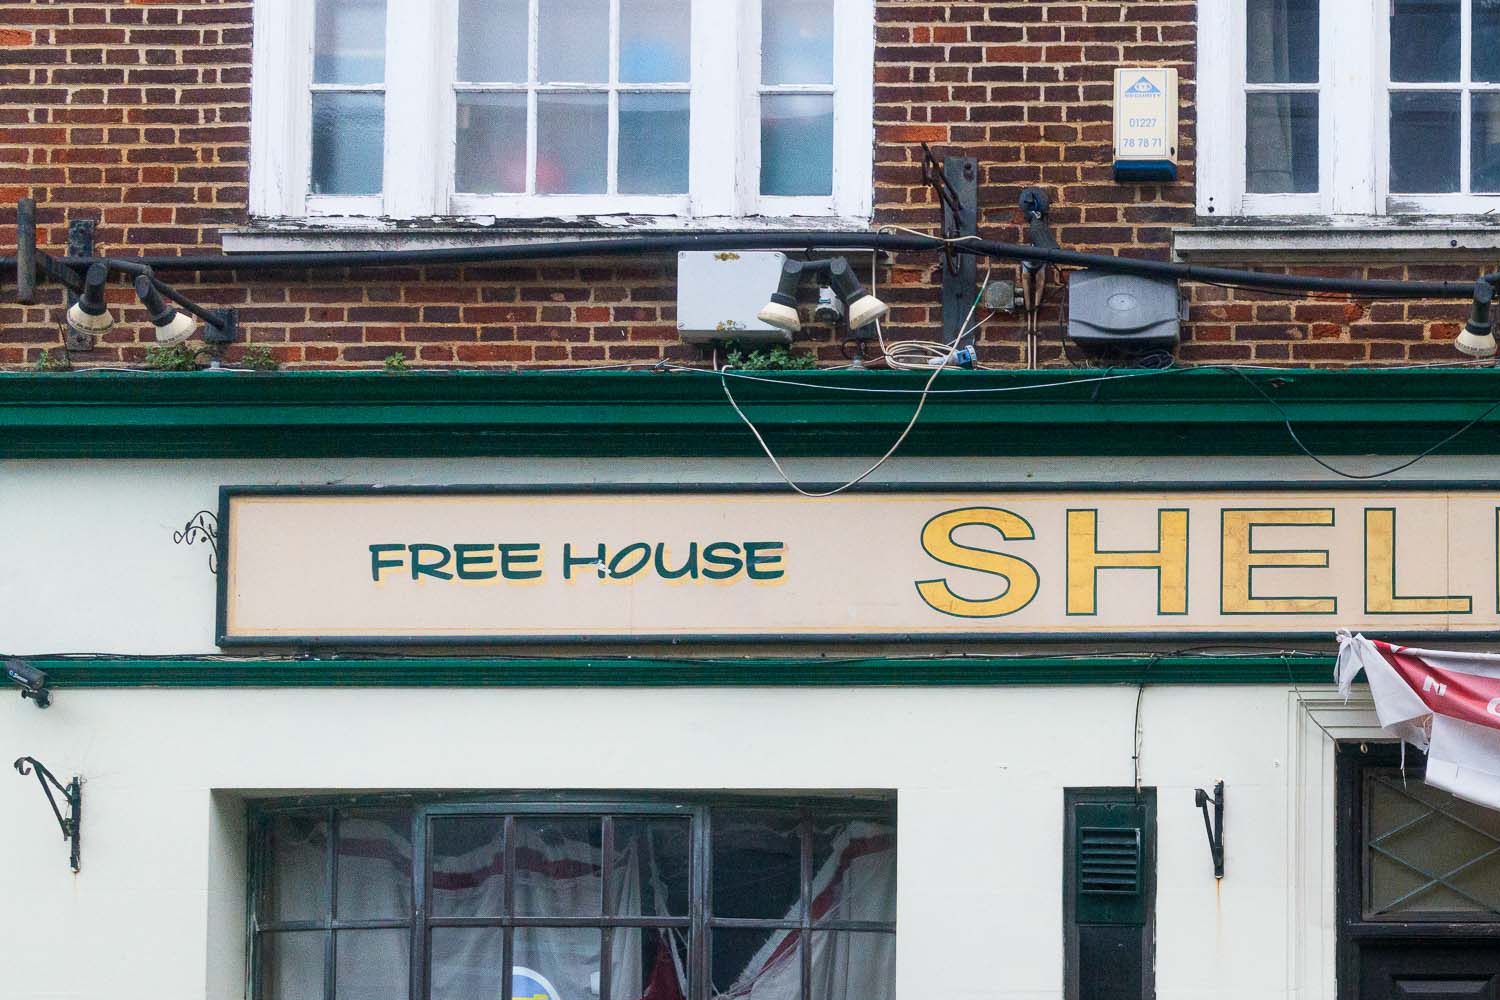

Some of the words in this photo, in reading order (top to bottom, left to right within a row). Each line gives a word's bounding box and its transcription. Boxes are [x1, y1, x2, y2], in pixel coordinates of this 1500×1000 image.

[1129, 118, 1157, 128] 01227
[1123, 138, 1136, 148] 78
[1138, 138, 1150, 148] 78
[1152, 138, 1162, 148] 71
[369, 543, 545, 584] FREE
[563, 541, 788, 584] HOUSE
